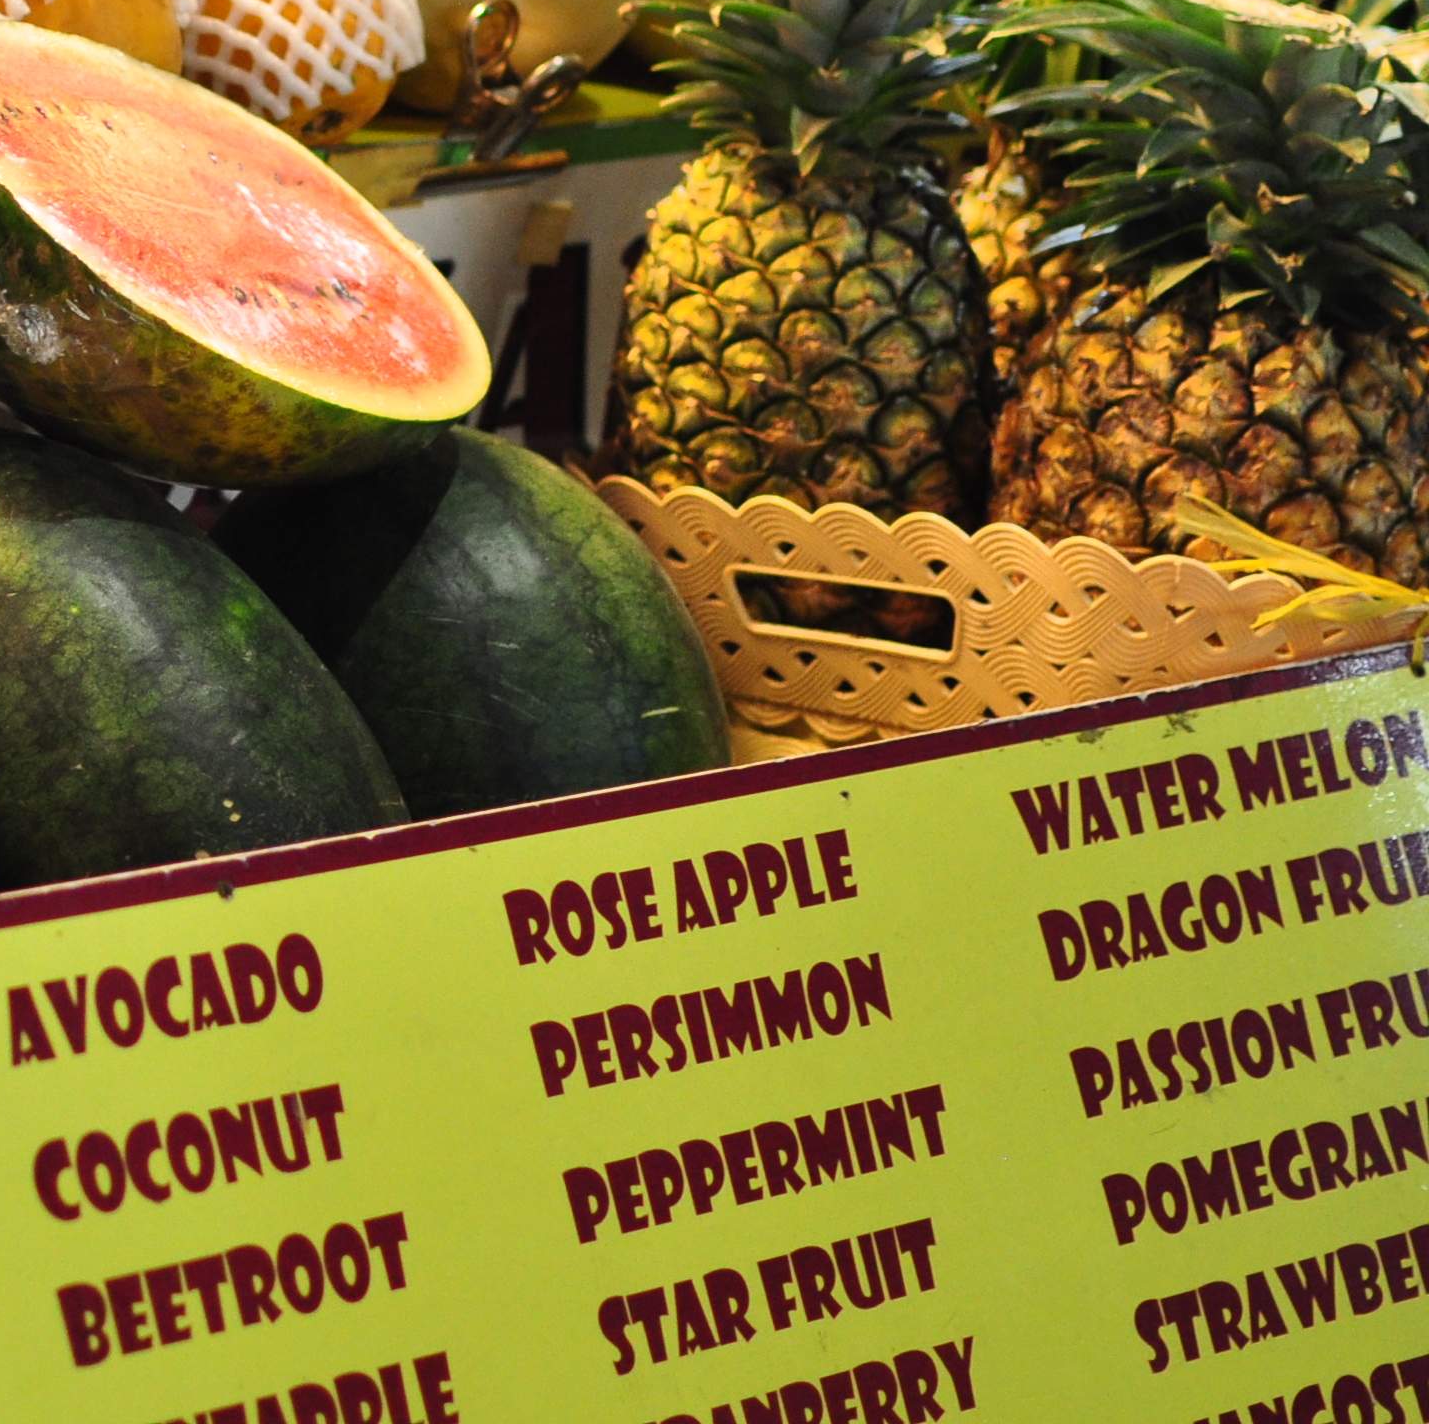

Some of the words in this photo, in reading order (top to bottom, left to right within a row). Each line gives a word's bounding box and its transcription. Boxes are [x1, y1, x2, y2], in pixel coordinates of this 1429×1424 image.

[1009, 753, 1227, 856] WATER
[1226, 710, 1429, 813] MELON
[502, 866, 664, 967] ROSE
[672, 828, 858, 935] APPLE
[1037, 864, 1286, 983] DRAGON
[7, 932, 325, 1068] AVOCADO
[529, 952, 893, 1099] PERSIMMON
[1068, 997, 1318, 1120] PASSION
[32, 1082, 346, 1224] COCONUT
[562, 1083, 947, 1246] PEPPERMINT
[55, 1210, 409, 1369] BEETROOT
[596, 1267, 758, 1377] STAR
[755, 1217, 937, 1333] FRUIT
